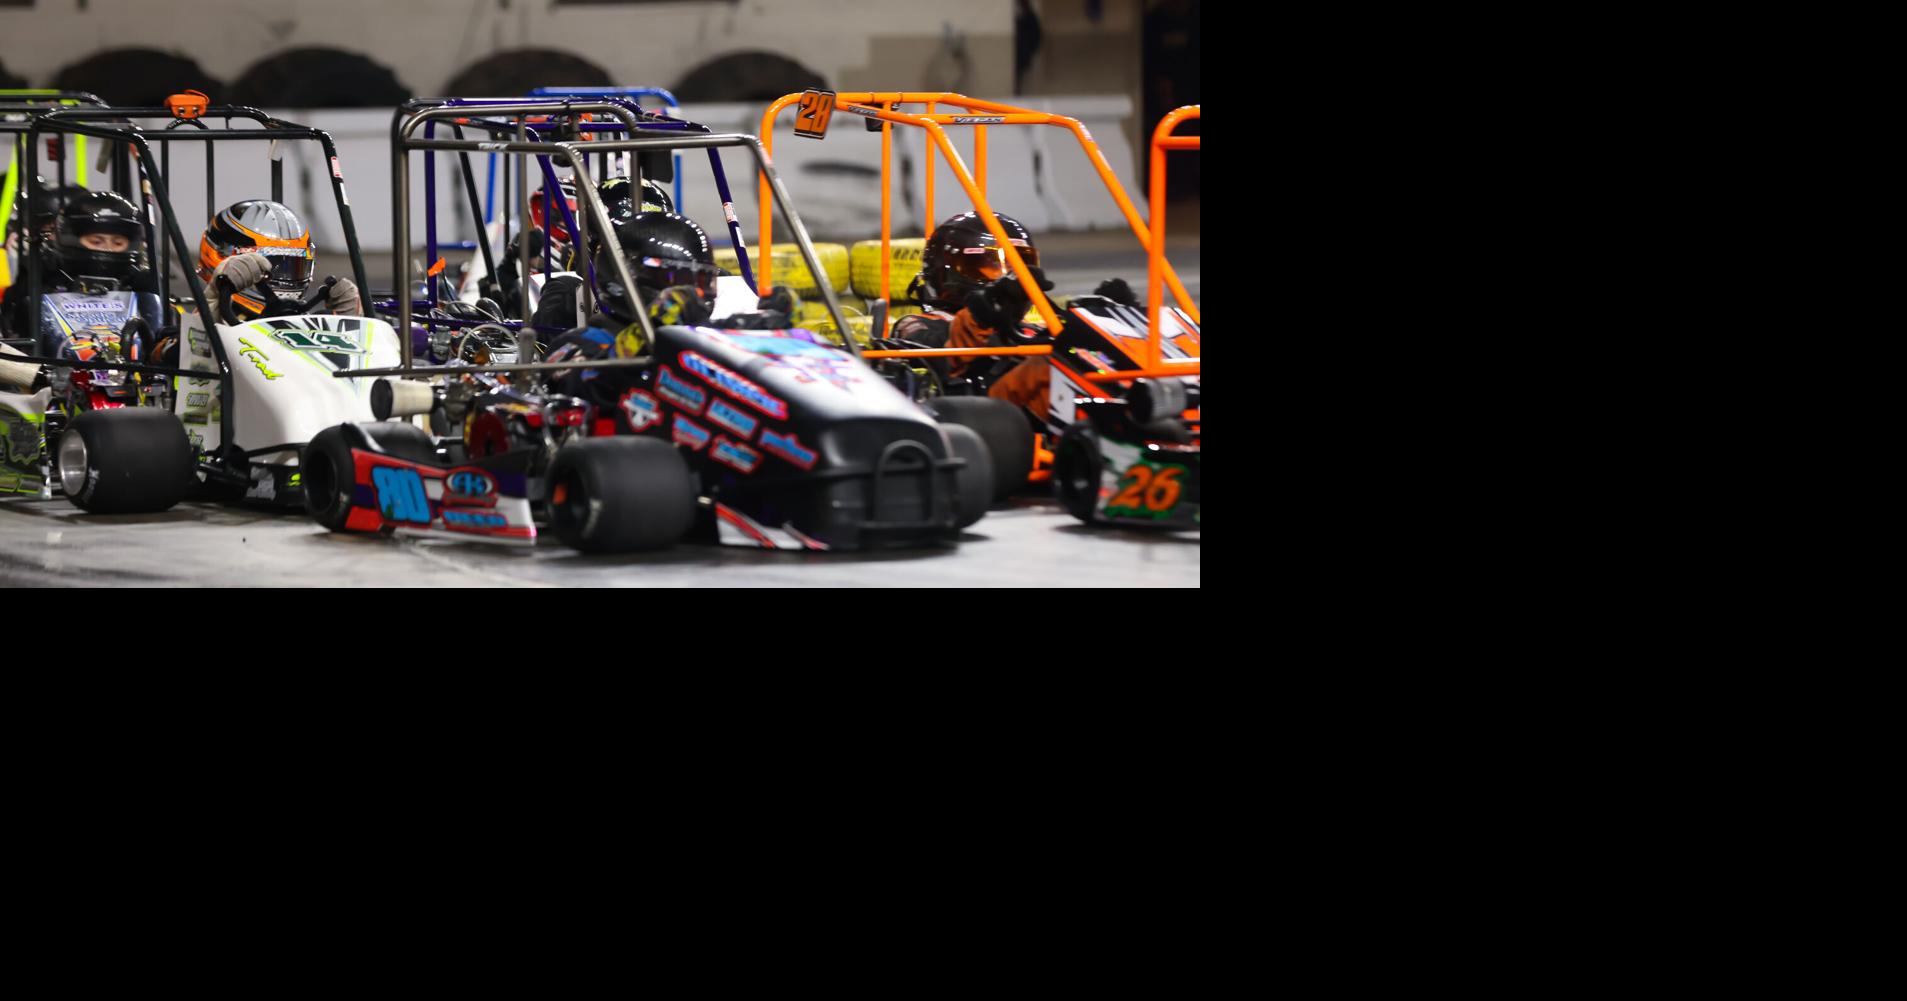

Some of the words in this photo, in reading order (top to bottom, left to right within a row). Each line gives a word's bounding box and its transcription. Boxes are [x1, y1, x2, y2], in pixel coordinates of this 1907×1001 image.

[795, 92, 833, 133] 28
[372, 466, 431, 523] 80
[1108, 464, 1184, 511] 26
